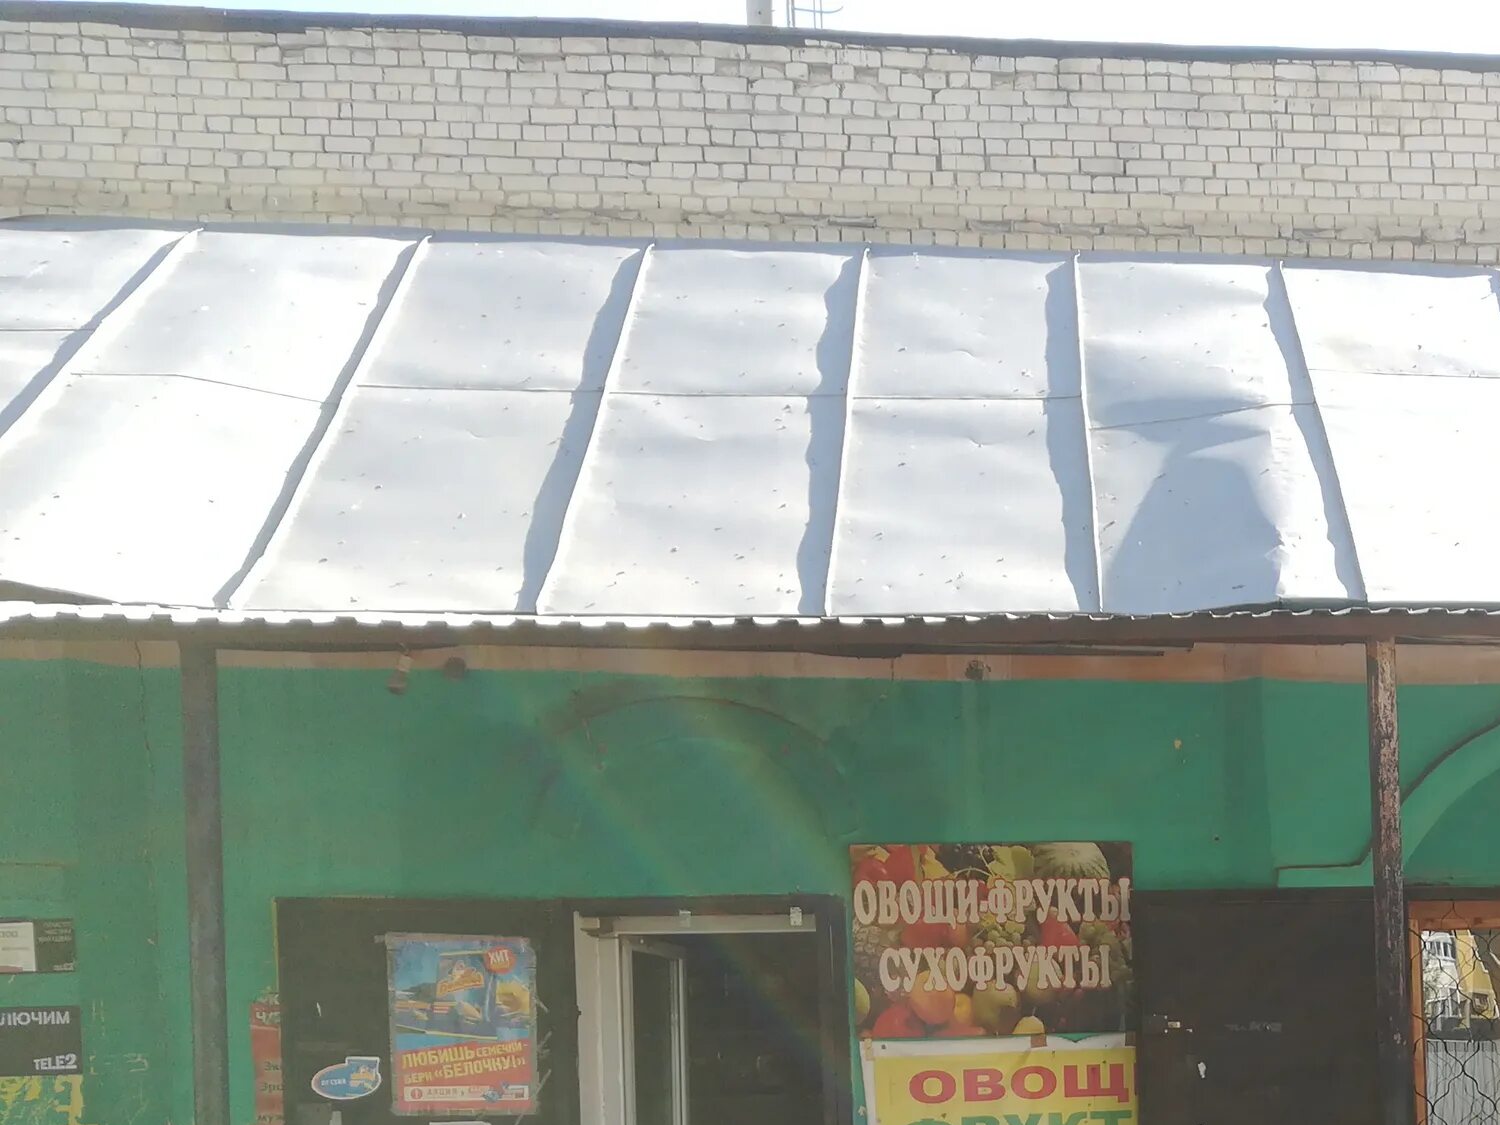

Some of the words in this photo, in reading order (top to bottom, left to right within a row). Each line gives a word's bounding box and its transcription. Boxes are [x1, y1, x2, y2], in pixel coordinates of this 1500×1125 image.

[488, 949, 509, 965] ХИТ
[879, 945, 1112, 992] СУХОФРУКТЫ
[33, 1053, 77, 1070] TELE2
[402, 1046, 475, 1069] ЛЮБИШЬ
[909, 1063, 1140, 1104] ОВОЩ
